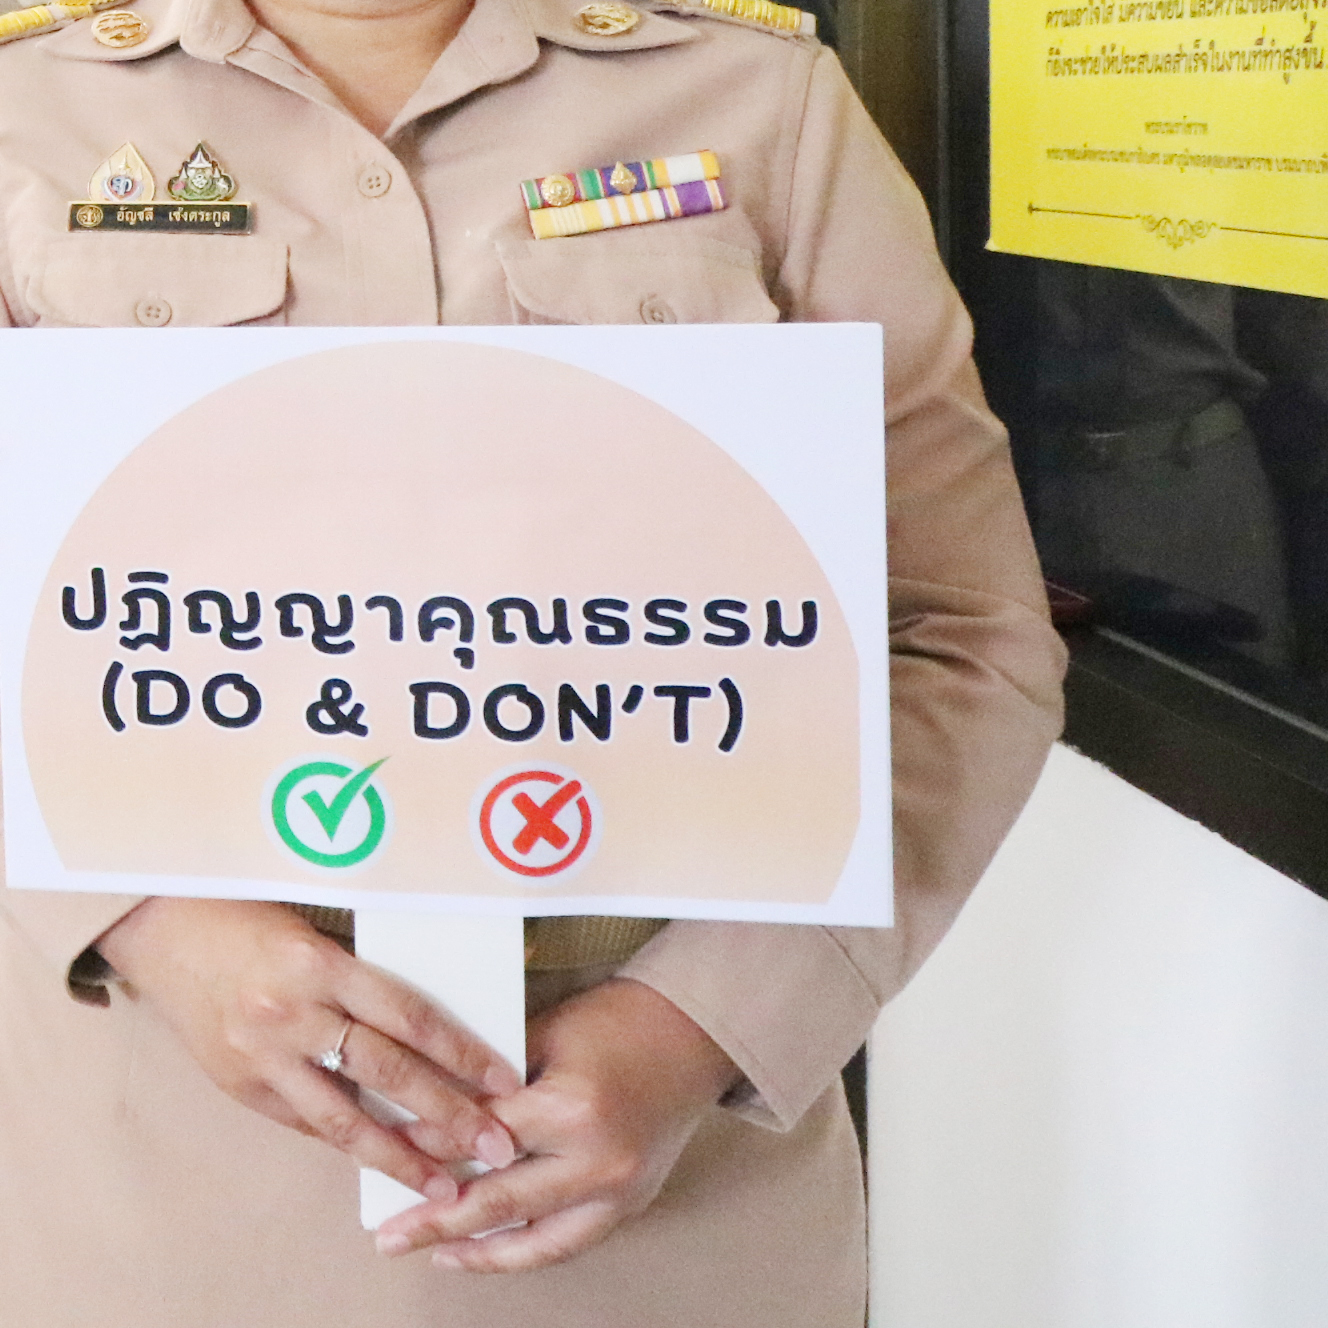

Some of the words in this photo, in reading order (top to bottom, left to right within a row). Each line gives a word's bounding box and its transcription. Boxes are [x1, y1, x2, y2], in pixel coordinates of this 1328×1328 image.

[60, 567, 819, 669] ปฏิญญาคุณธรรม
[101, 660, 264, 734] (DO
[305, 676, 369, 739] &
[409, 677, 745, 754] DON'T)
